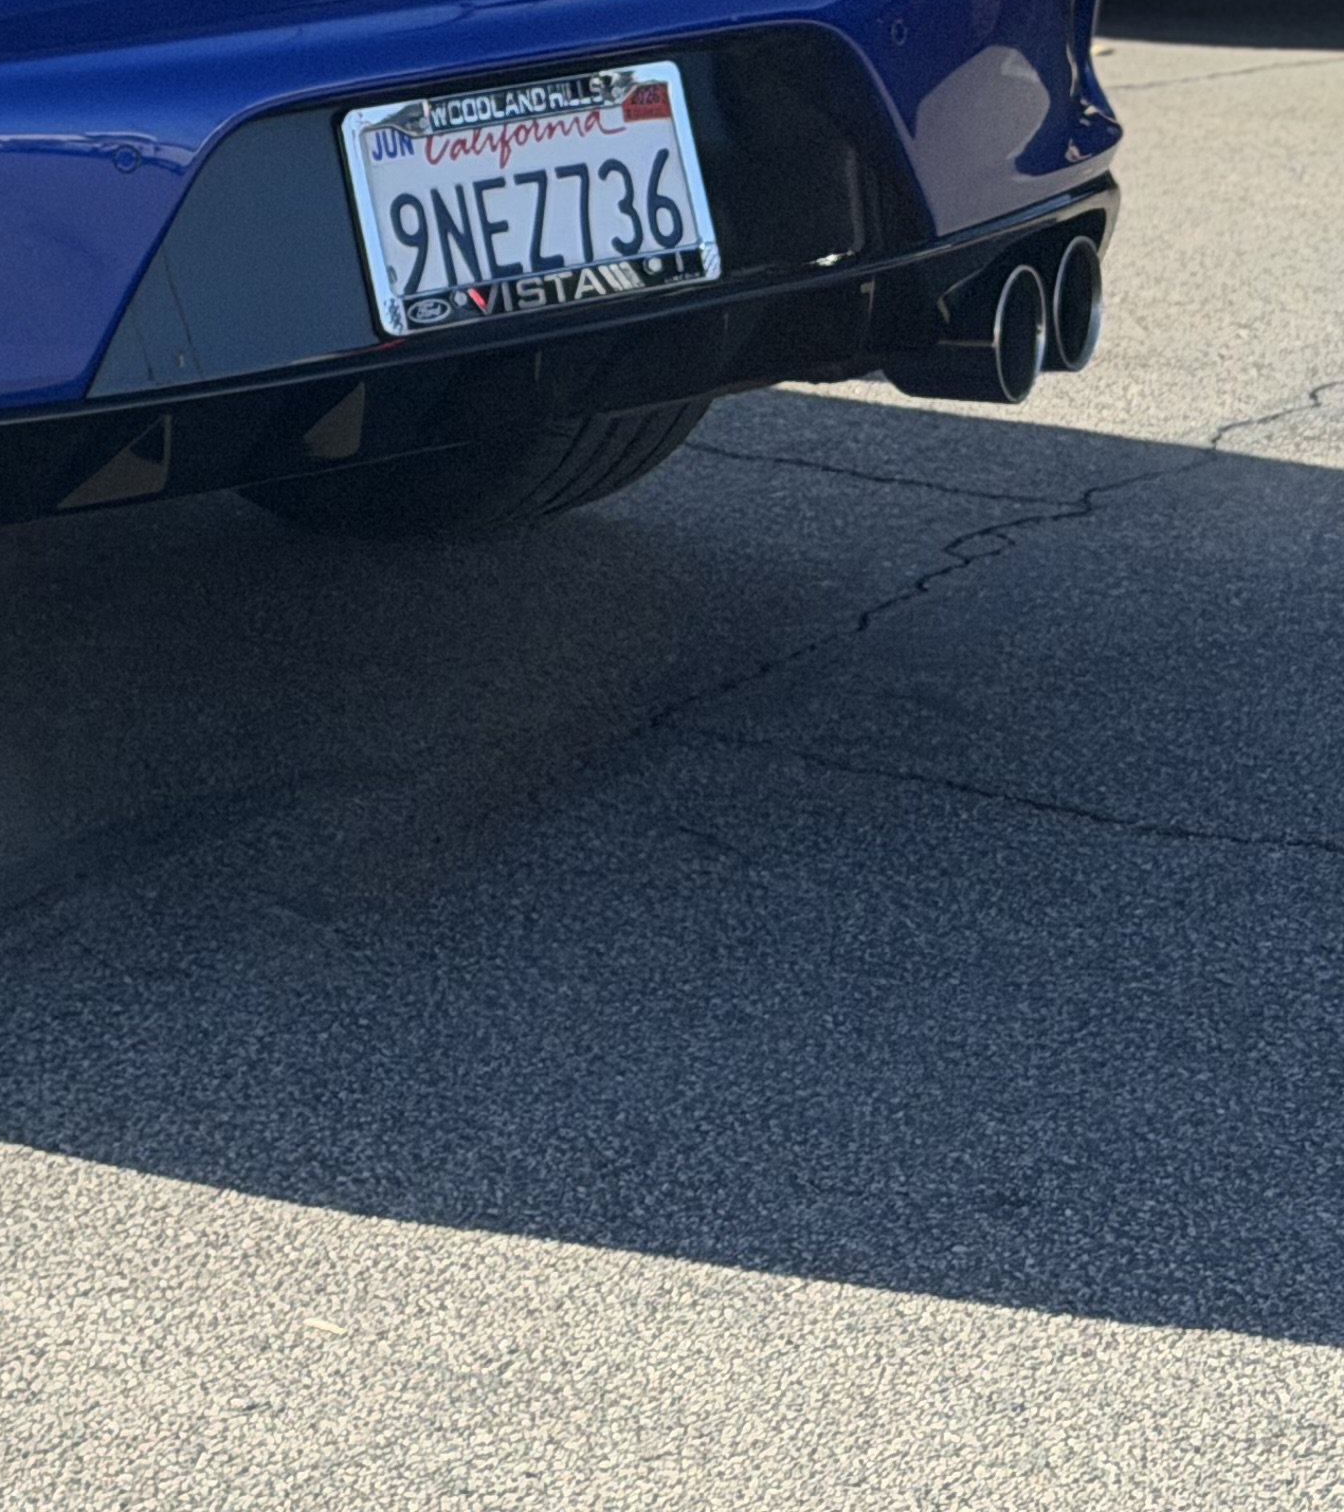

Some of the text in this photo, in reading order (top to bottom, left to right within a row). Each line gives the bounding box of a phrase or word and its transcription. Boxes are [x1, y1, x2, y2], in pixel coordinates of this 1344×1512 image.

[431, 76, 604, 128] WOODLAND HILLS
[372, 129, 415, 162] JUN
[425, 107, 627, 169] California
[390, 149, 684, 296] 9NEZ736
[467, 267, 607, 316] VISTA
